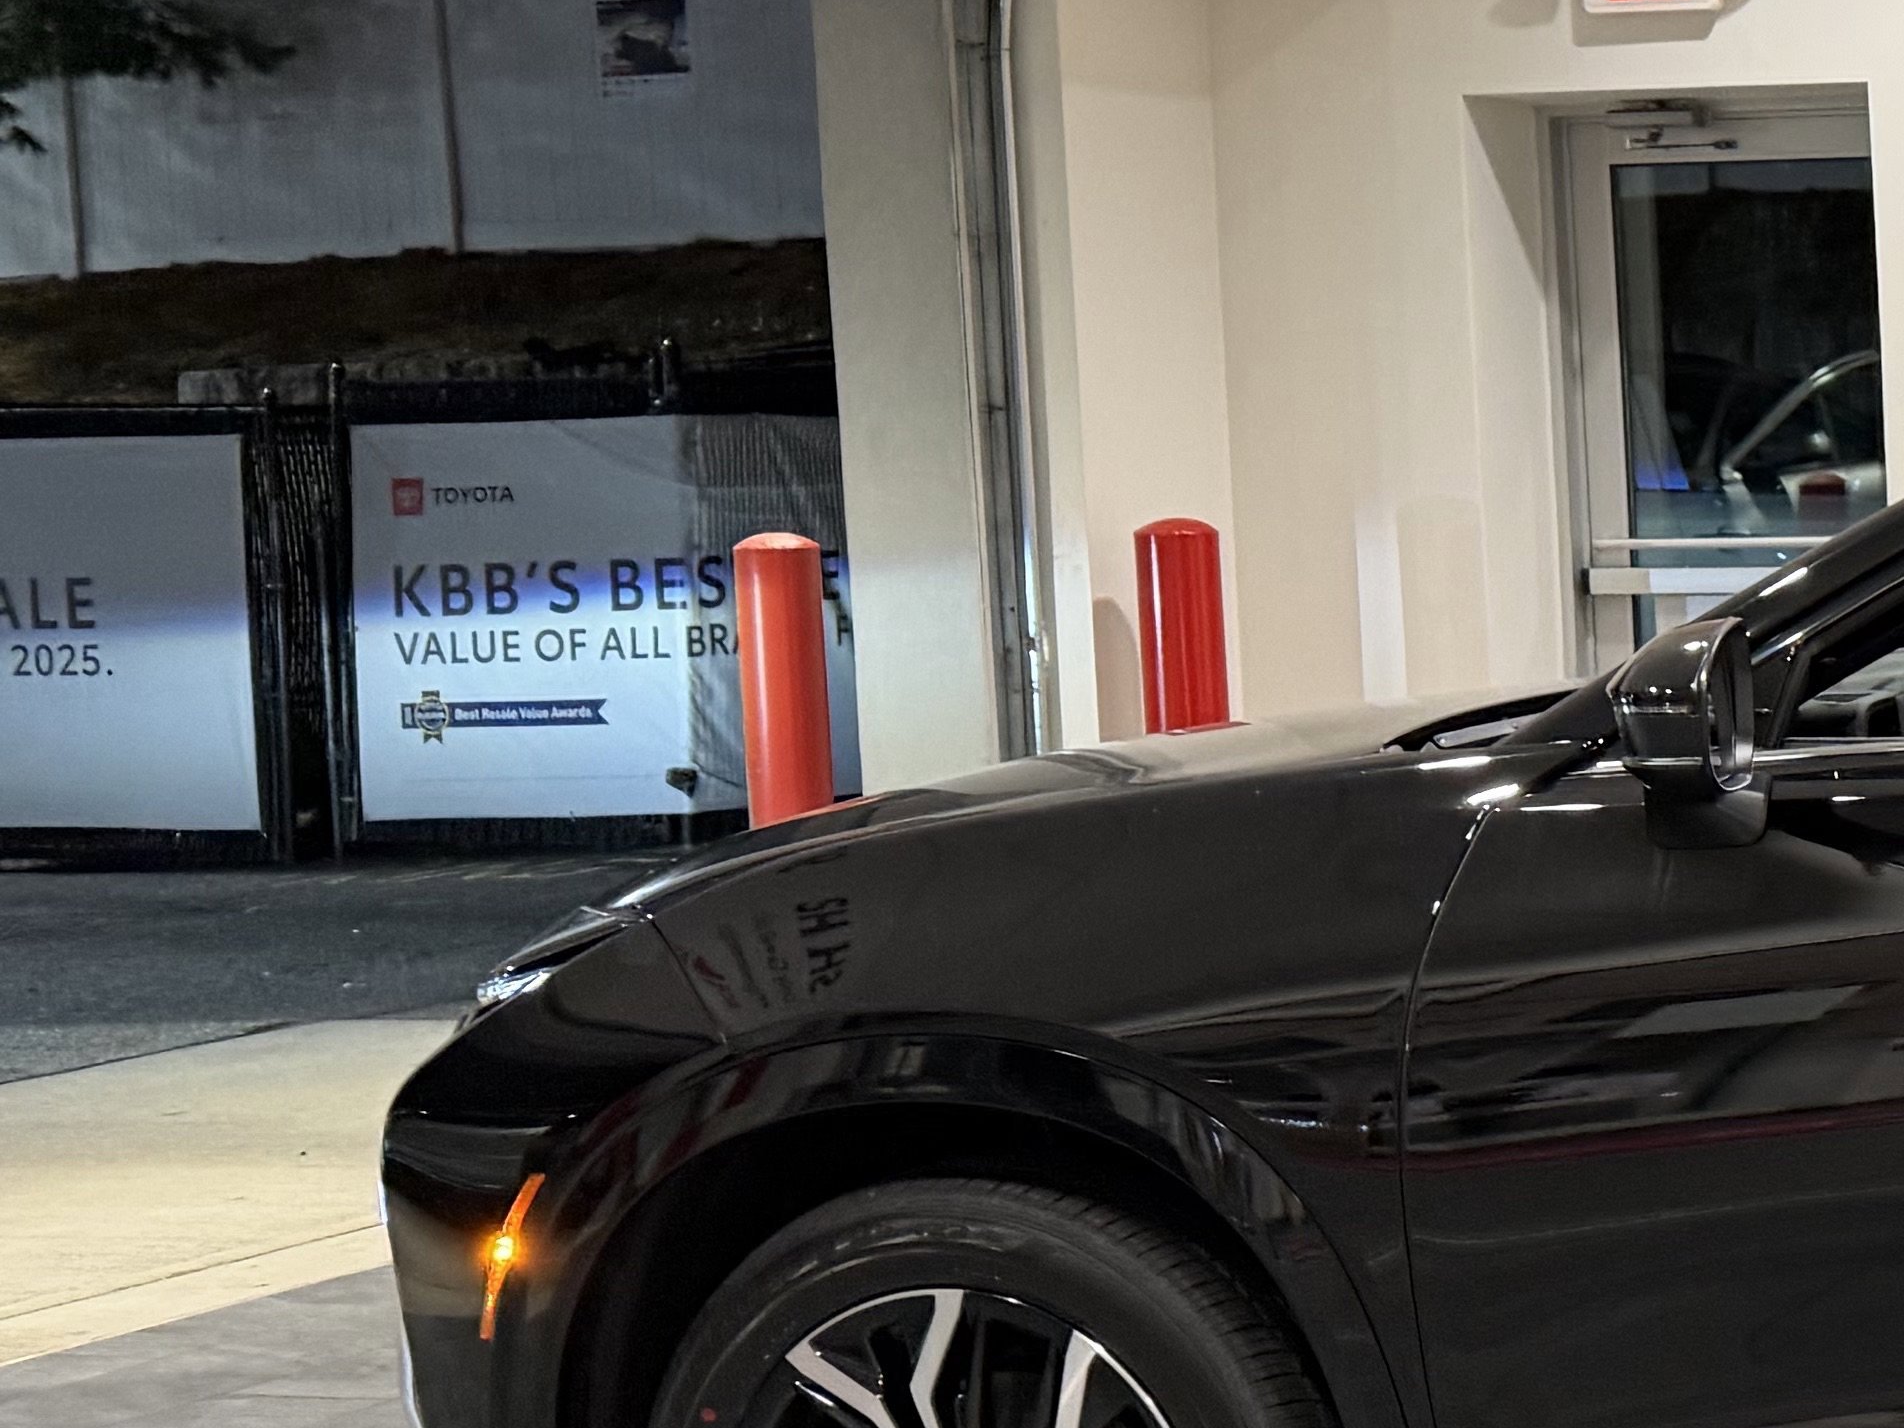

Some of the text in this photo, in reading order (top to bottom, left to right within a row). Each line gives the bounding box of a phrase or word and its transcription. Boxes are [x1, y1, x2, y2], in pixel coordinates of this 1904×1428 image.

[432, 486, 515, 506] TOYOTA
[393, 548, 735, 618] KBB'S BES
[11, 643, 113, 676] 2025.
[393, 629, 521, 665] VALUE
[534, 627, 587, 662] OF
[600, 625, 672, 660] ALL
